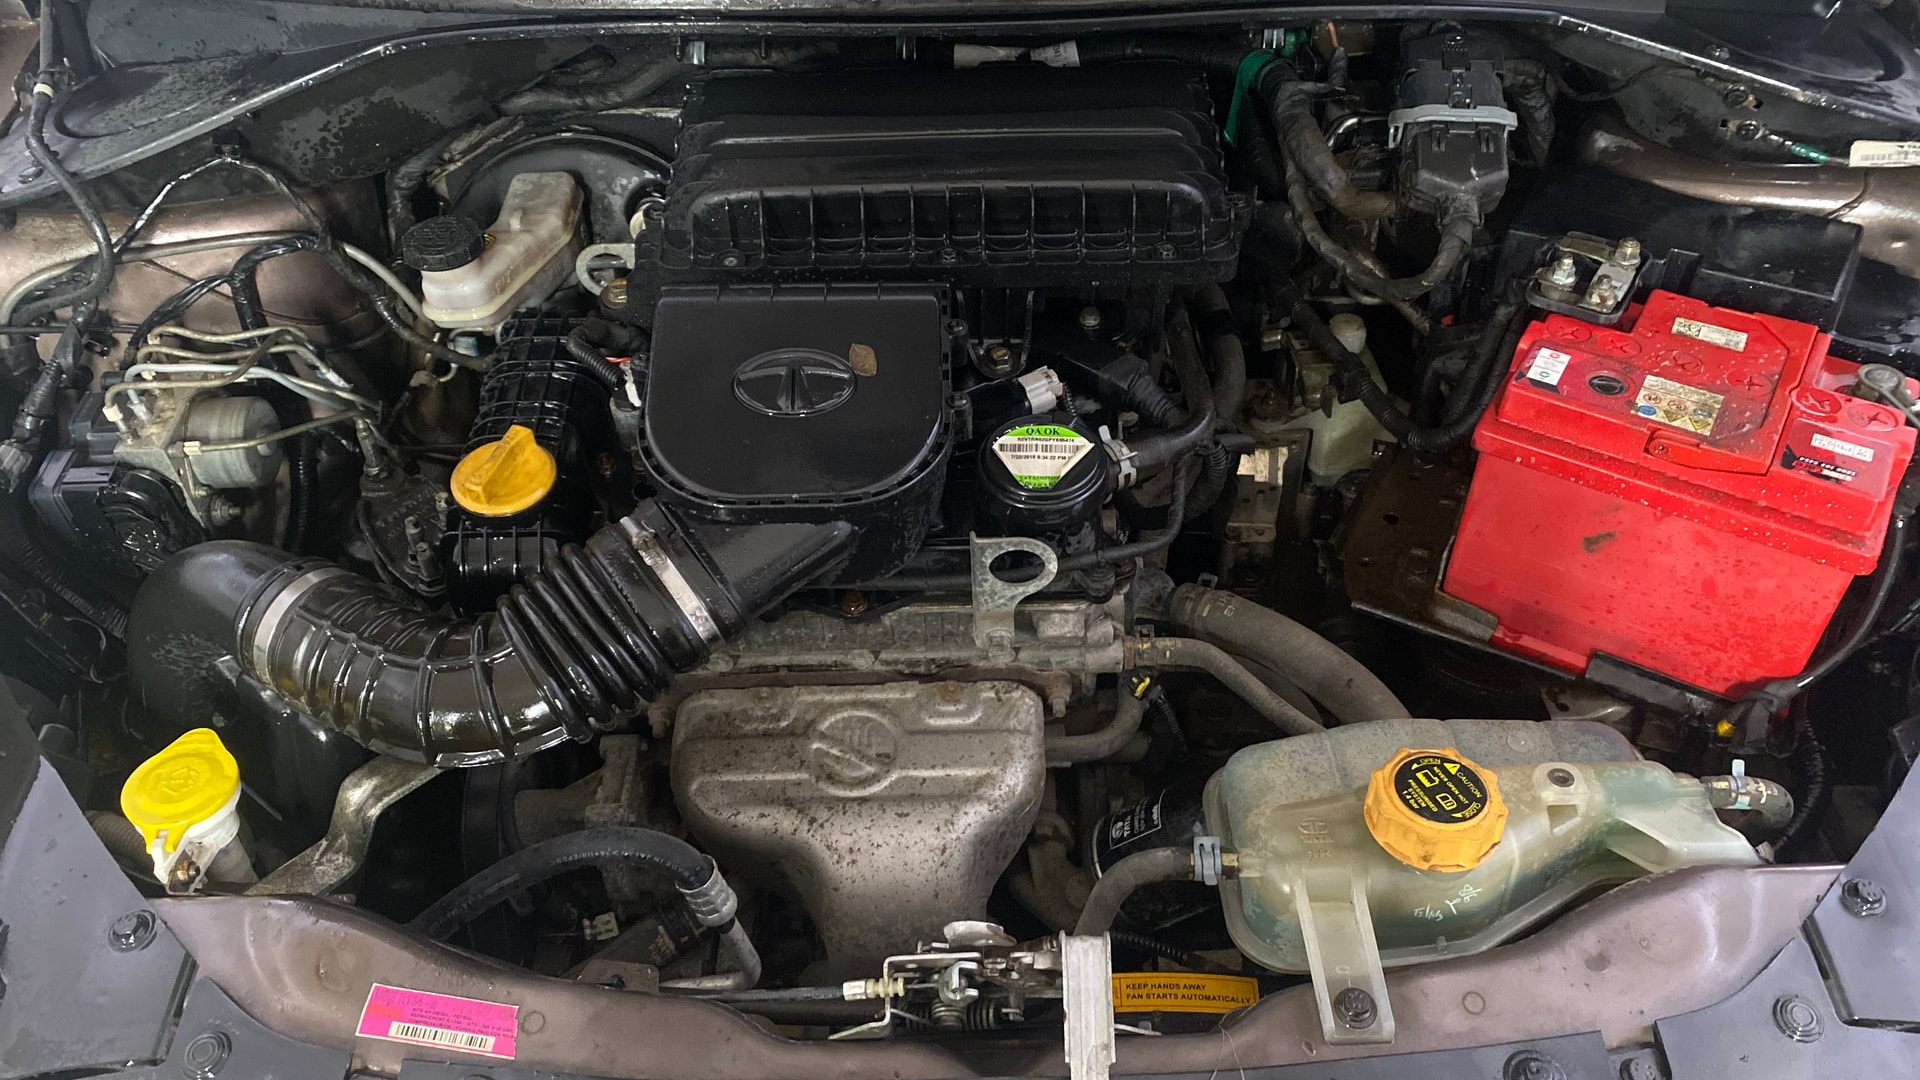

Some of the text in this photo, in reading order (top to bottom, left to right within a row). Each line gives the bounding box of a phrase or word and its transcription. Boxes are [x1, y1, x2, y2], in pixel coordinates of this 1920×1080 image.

[1026, 427, 1060, 436] QA OK
[1420, 757, 1440, 765] OPEN
[1432, 766, 1470, 805] NEVER OPEN HOT
[1456, 771, 1483, 798] CAUTION
[1407, 788, 1427, 808] SYSTEM
[1409, 799, 1420, 809] bar
[1462, 802, 1482, 819] CLOSE
[1180, 993, 1252, 1004] AUTOMATICALLY
